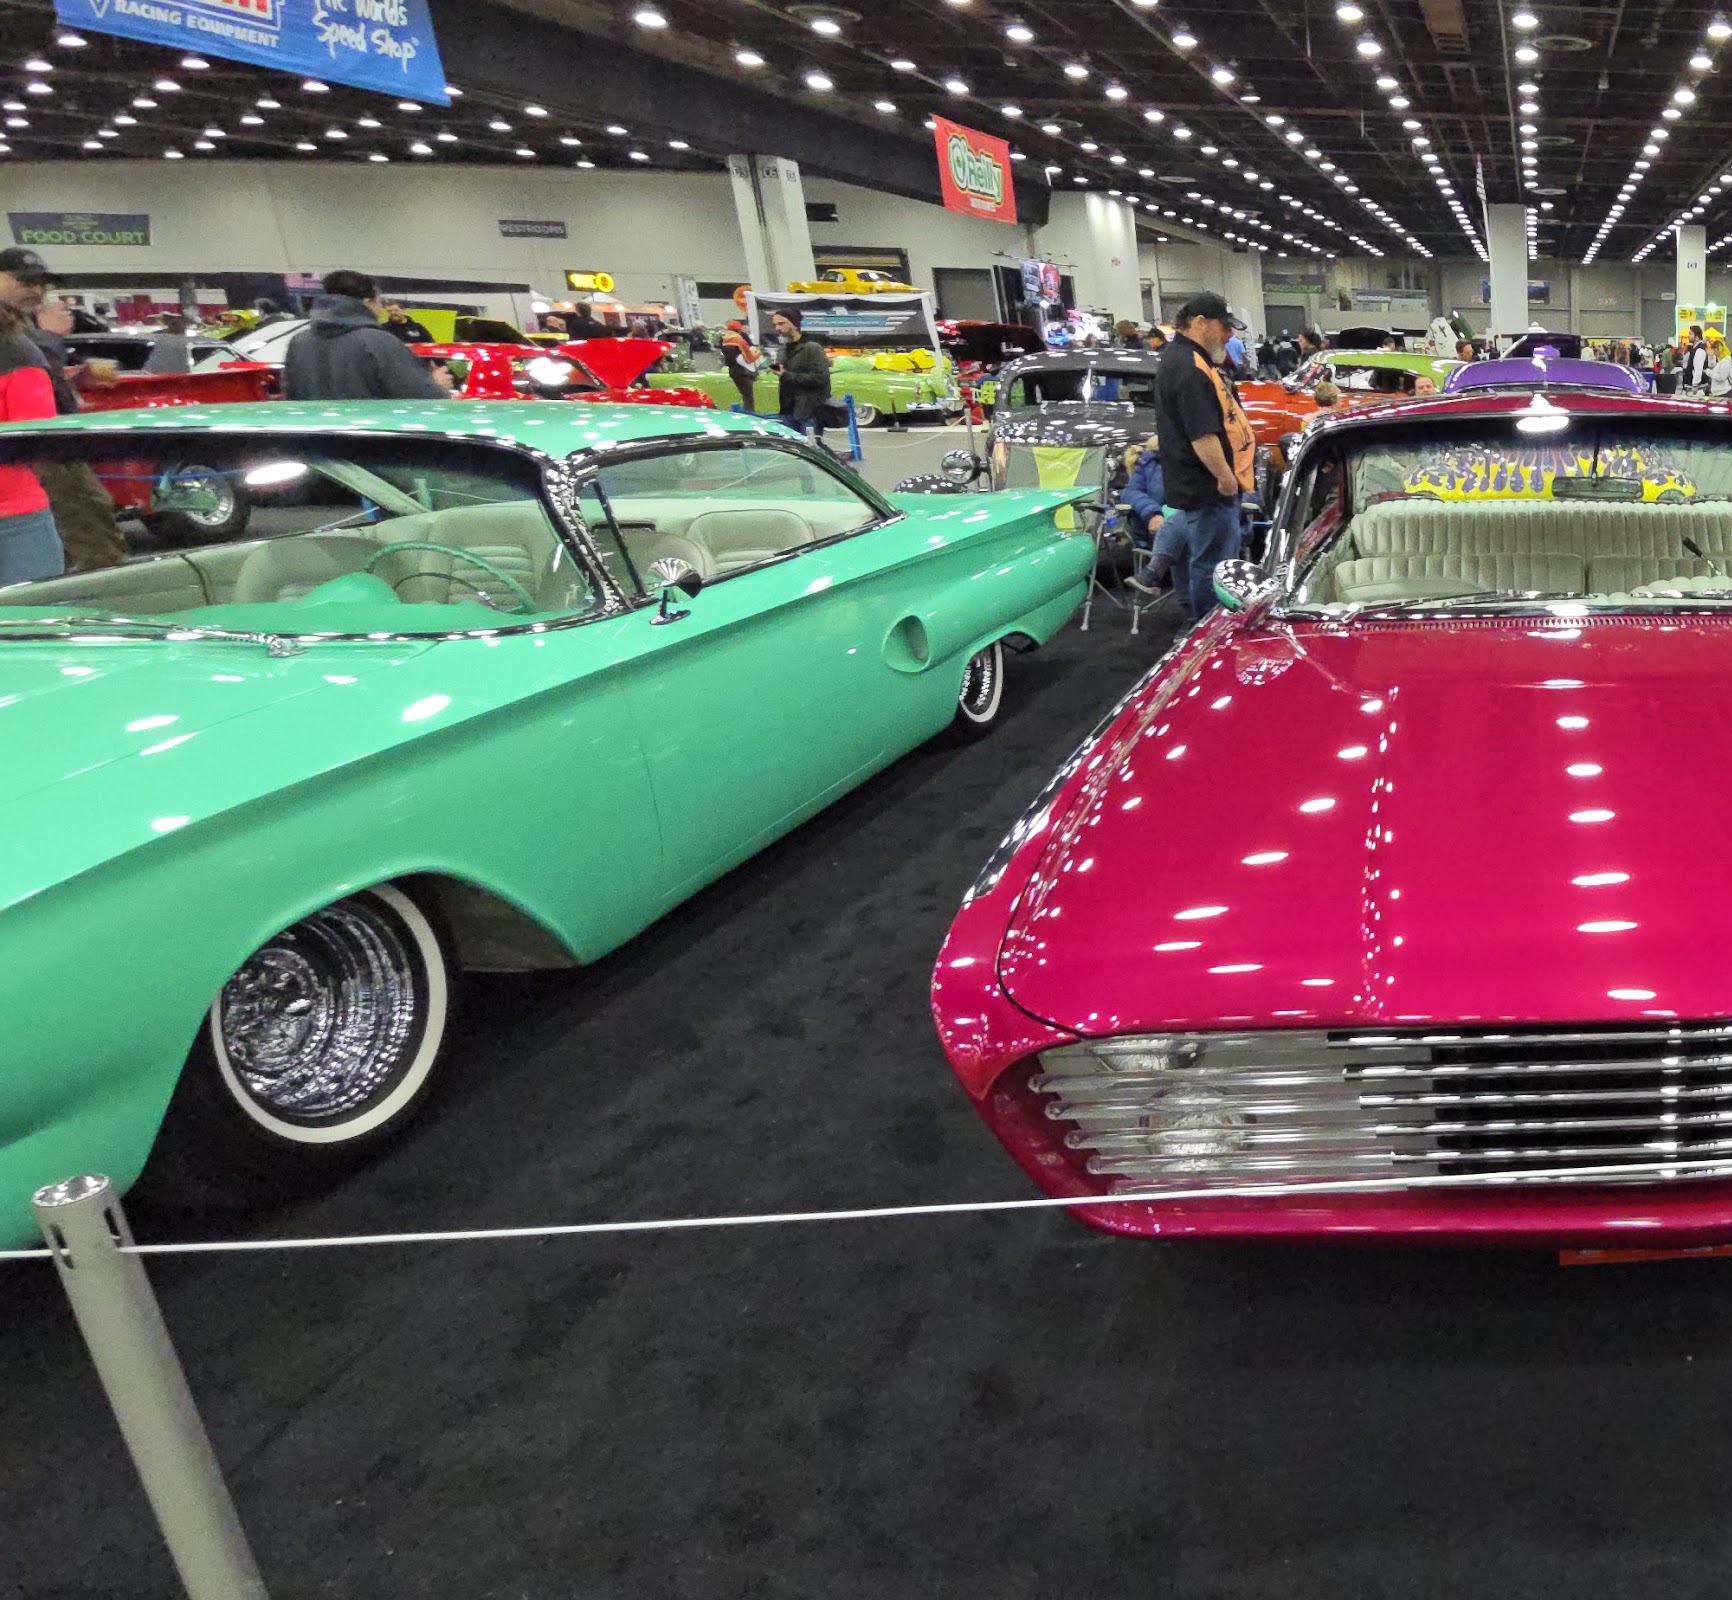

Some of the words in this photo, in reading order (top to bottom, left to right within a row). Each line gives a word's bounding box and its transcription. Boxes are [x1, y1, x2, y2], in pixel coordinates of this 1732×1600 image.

[115, 0, 182, 25] RACING
[186, 15, 280, 48] EQUIPMENT
[312, 10, 368, 59] Speed
[948, 134, 1002, 205] O'Reilly
[22, 230, 76, 244] FOOD
[81, 231, 145, 244] COURT
